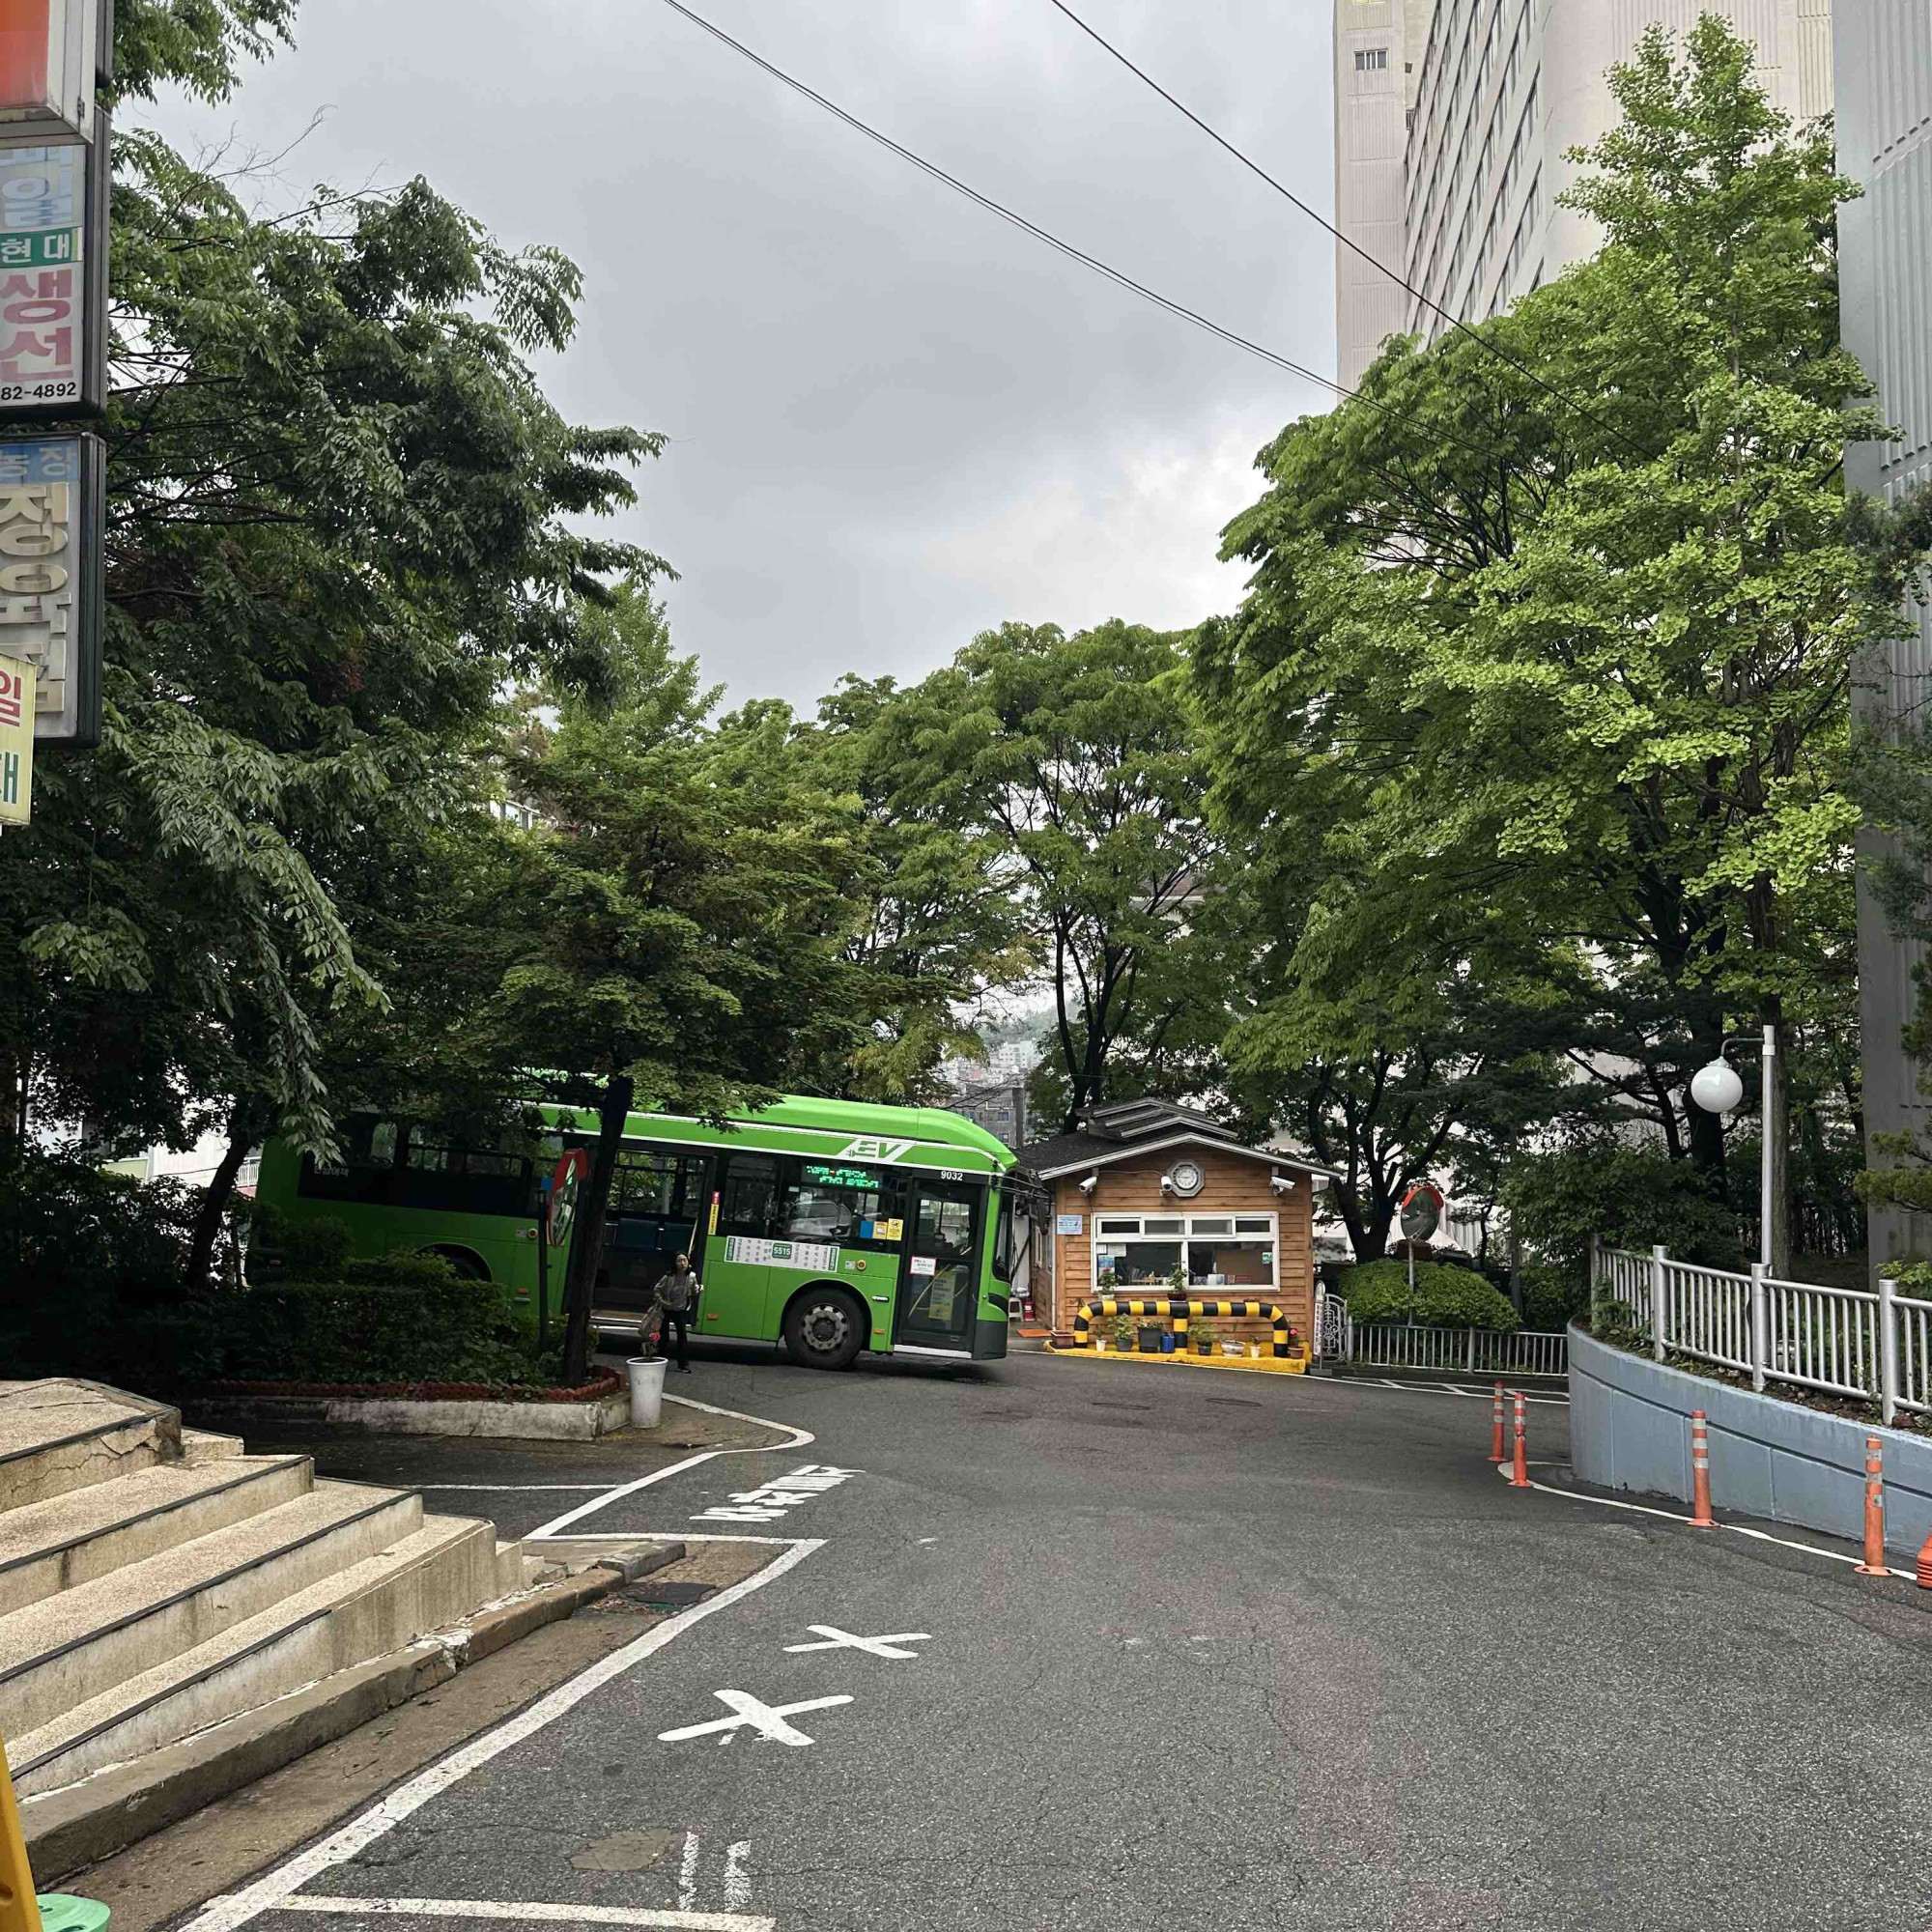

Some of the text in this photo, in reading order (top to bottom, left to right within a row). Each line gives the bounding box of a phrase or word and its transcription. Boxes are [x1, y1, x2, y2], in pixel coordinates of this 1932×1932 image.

[1, 234, 70, 263] 현대
[0, 269, 73, 384] 생선
[1, 383, 76, 401] 82-4892
[851, 1140, 901, 1159] EV
[940, 1170, 963, 1181] 9032
[773, 1246, 791, 1256] 5515
